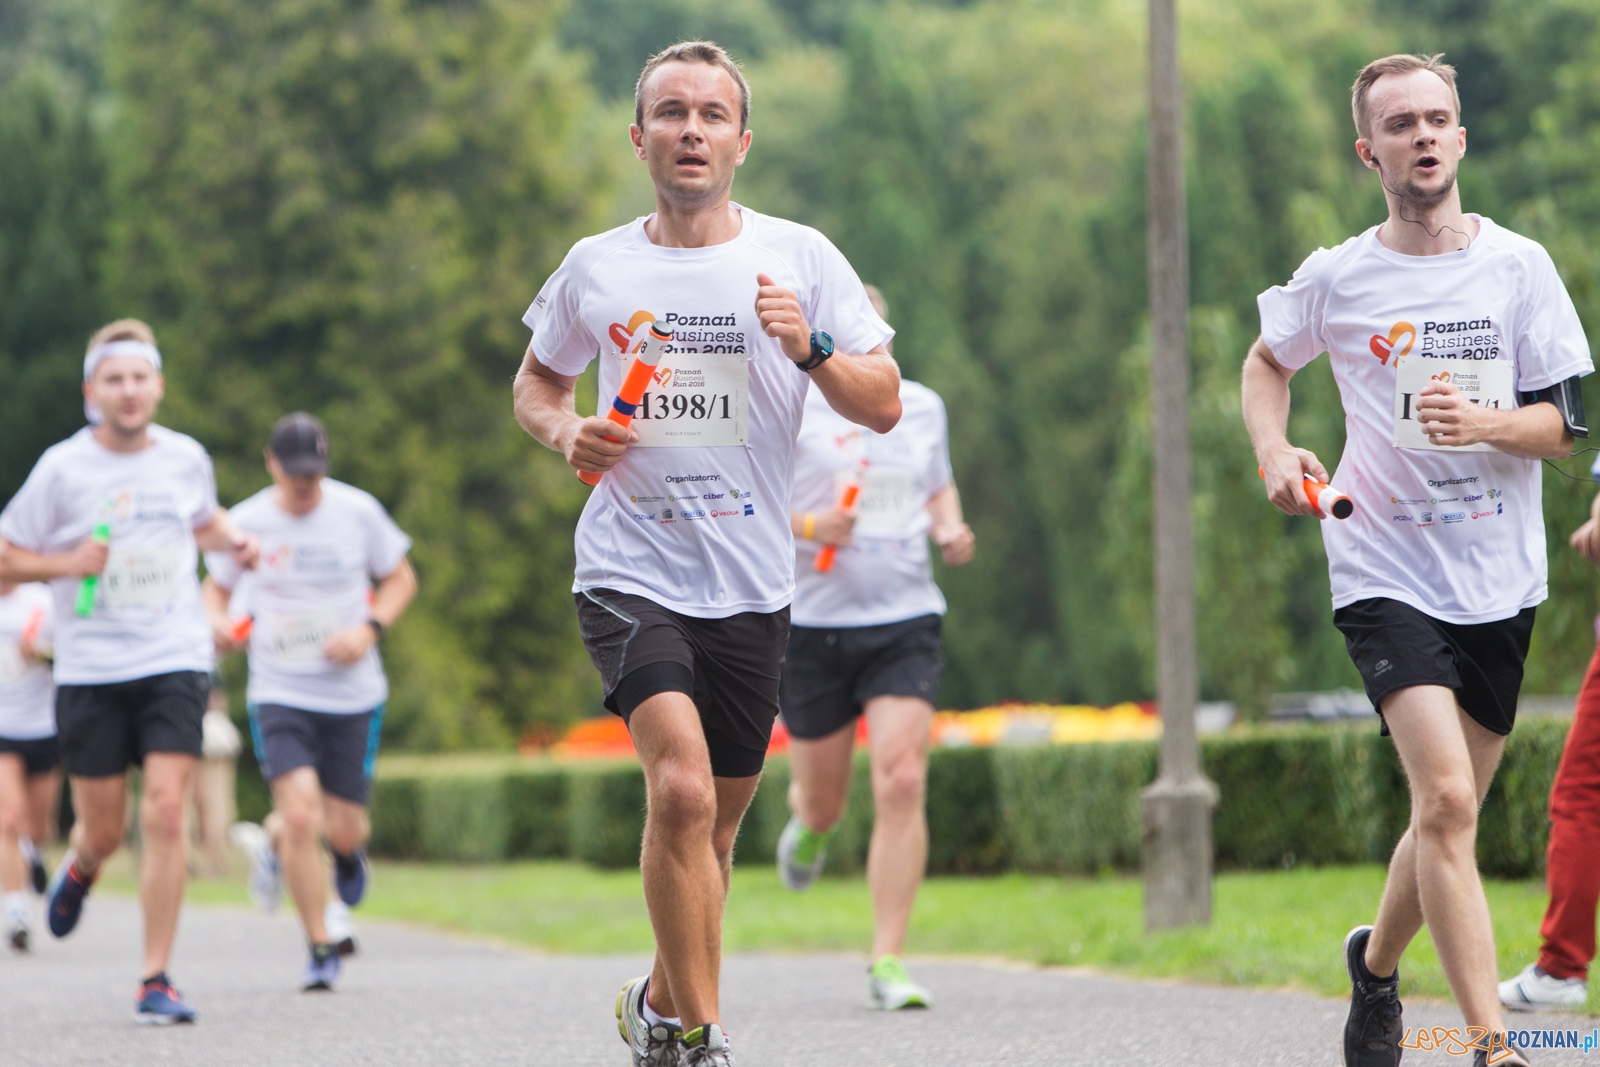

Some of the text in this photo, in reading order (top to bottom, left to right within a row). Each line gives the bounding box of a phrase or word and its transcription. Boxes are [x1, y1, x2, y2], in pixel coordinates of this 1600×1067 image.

[665, 312, 736, 327] Poznań
[1423, 316, 1491, 335] Poznań
[1422, 334, 1499, 351] Business
[665, 474, 721, 483] Organizatorzy:
[1428, 476, 1479, 488] Organizatorzy:
[703, 492, 725, 500] ciber
[1463, 494, 1484, 502] ciber
